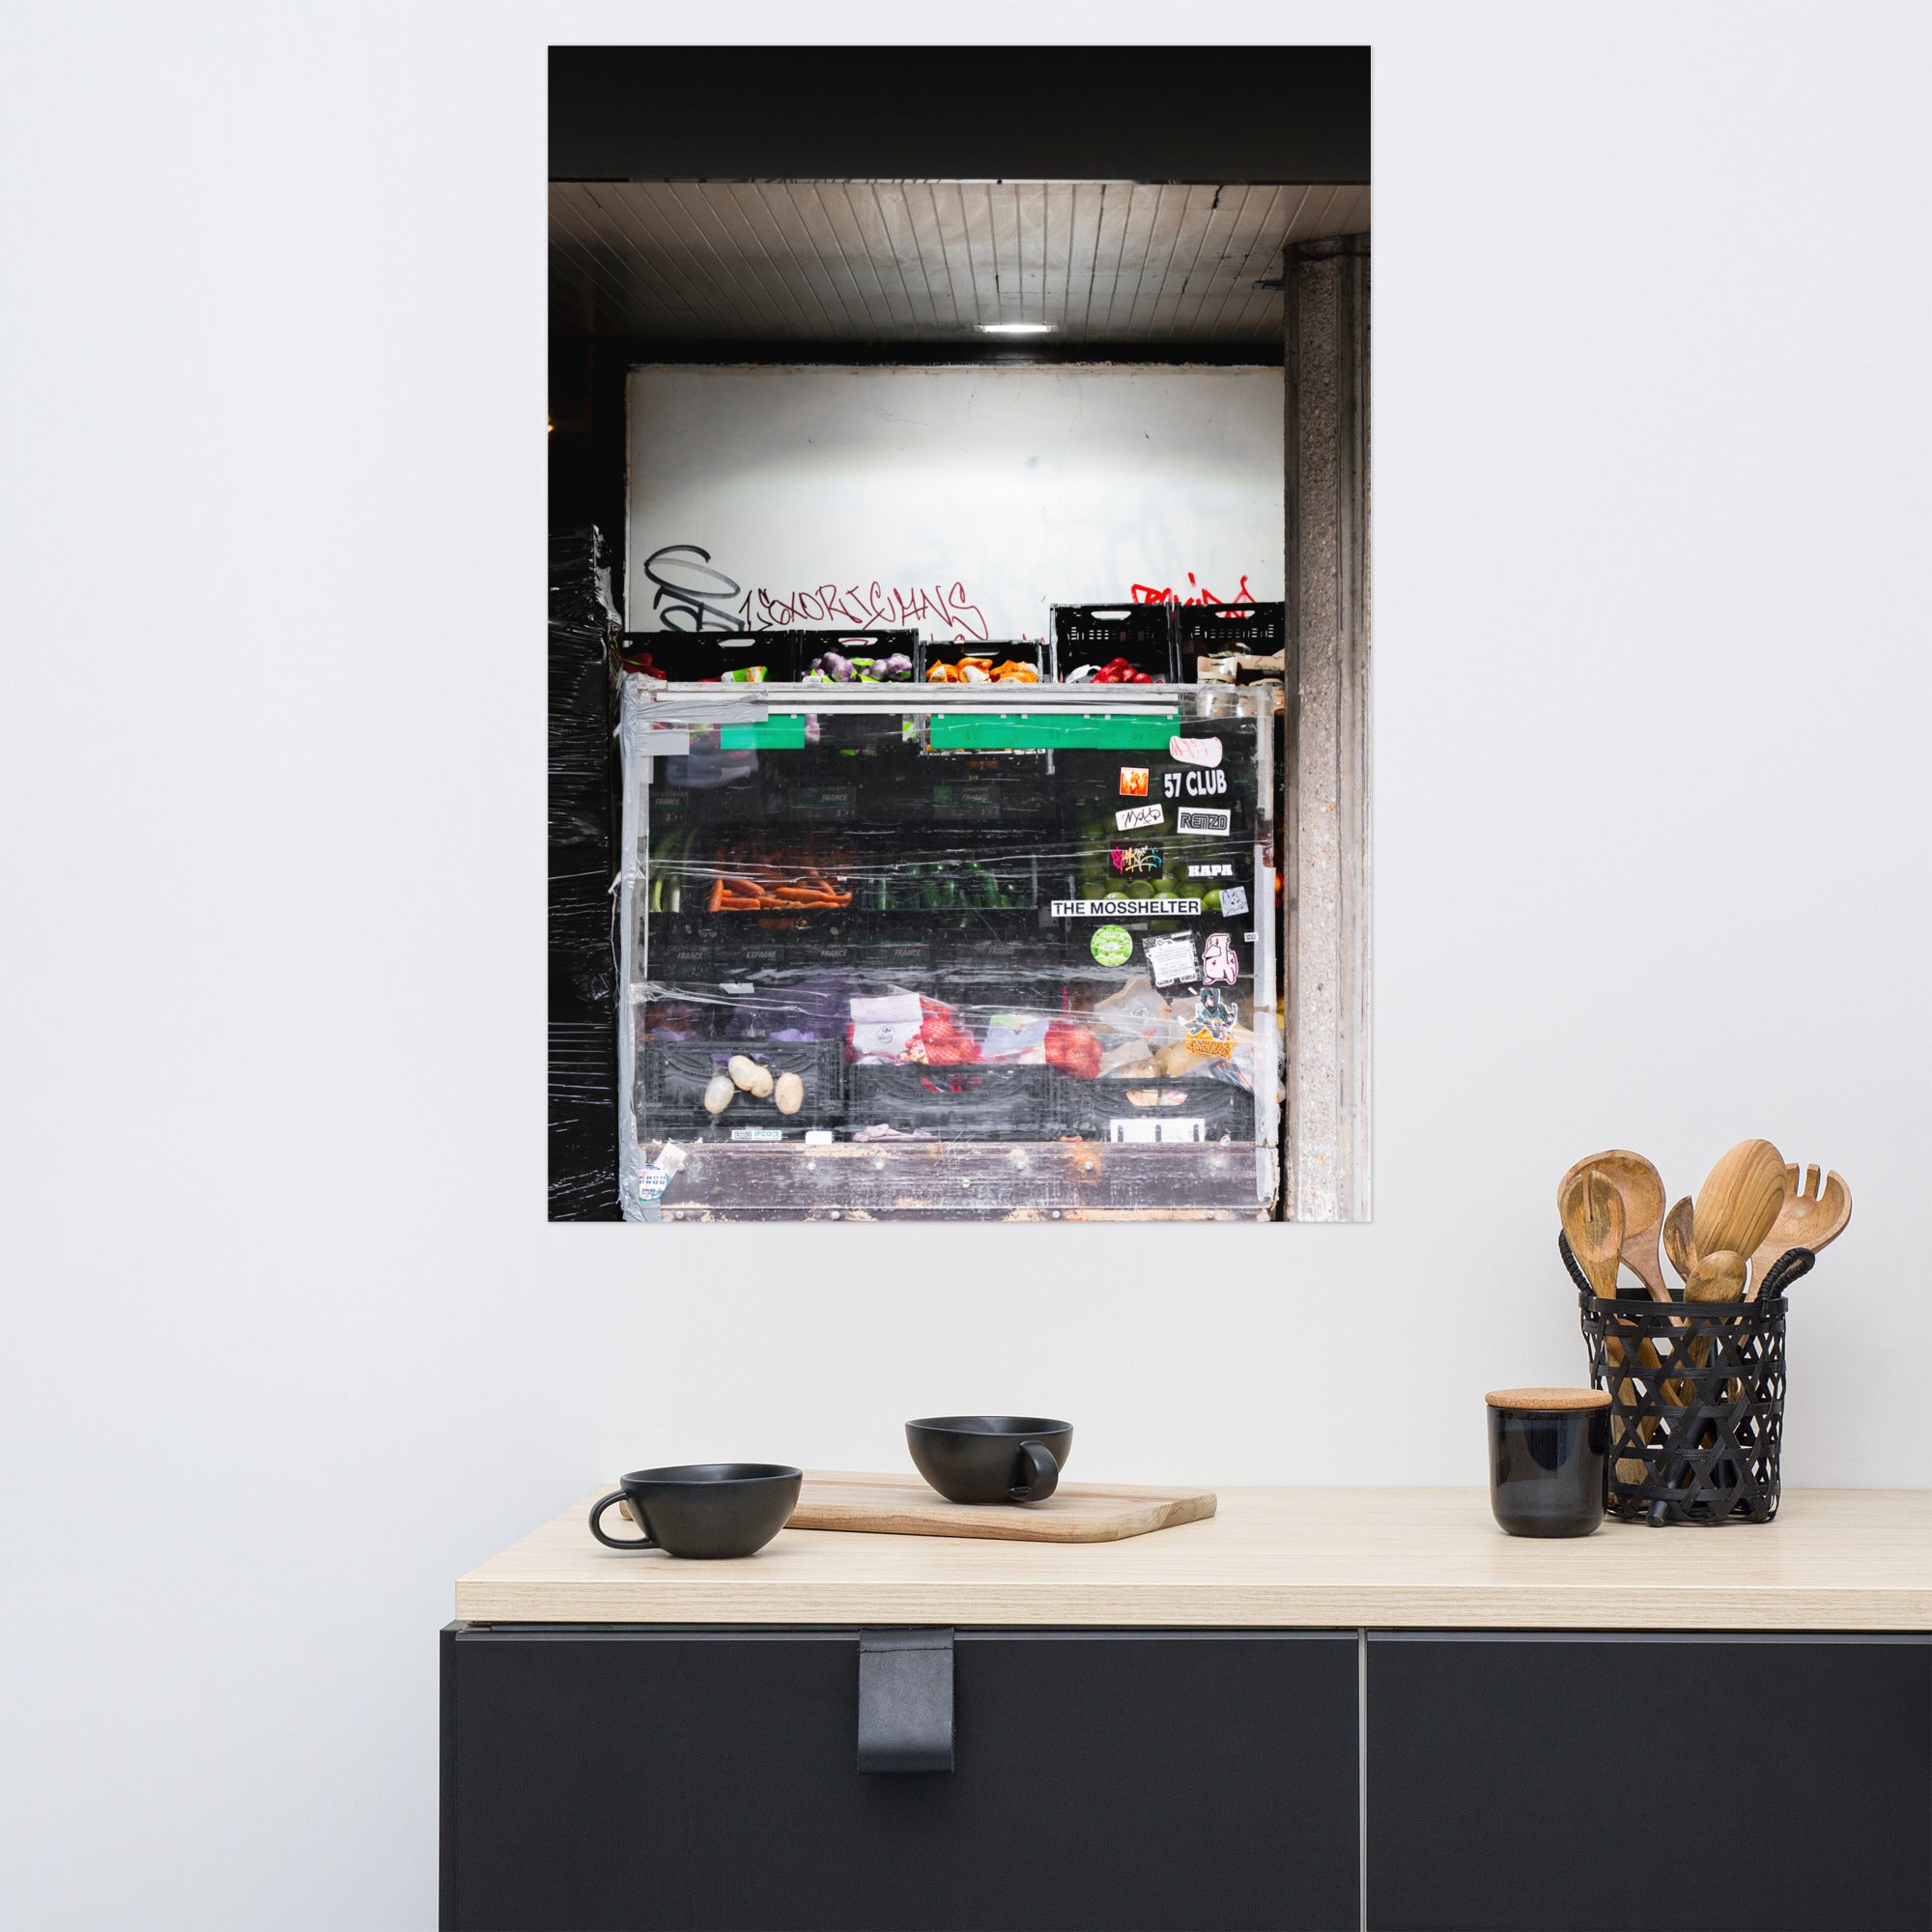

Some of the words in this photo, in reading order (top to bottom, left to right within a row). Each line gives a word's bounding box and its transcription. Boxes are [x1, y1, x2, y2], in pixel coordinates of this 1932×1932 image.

[1163, 772, 1182, 799] 57
[1185, 769, 1228, 797] CLUB
[1179, 811, 1228, 831] RENZO
[1053, 901, 1086, 916] THE
[1090, 900, 1200, 915] MOSSHELTER
[677, 952, 705, 960] FRANCE
[746, 951, 777, 959] ESPAGNE
[894, 949, 922, 957] FRANCE
